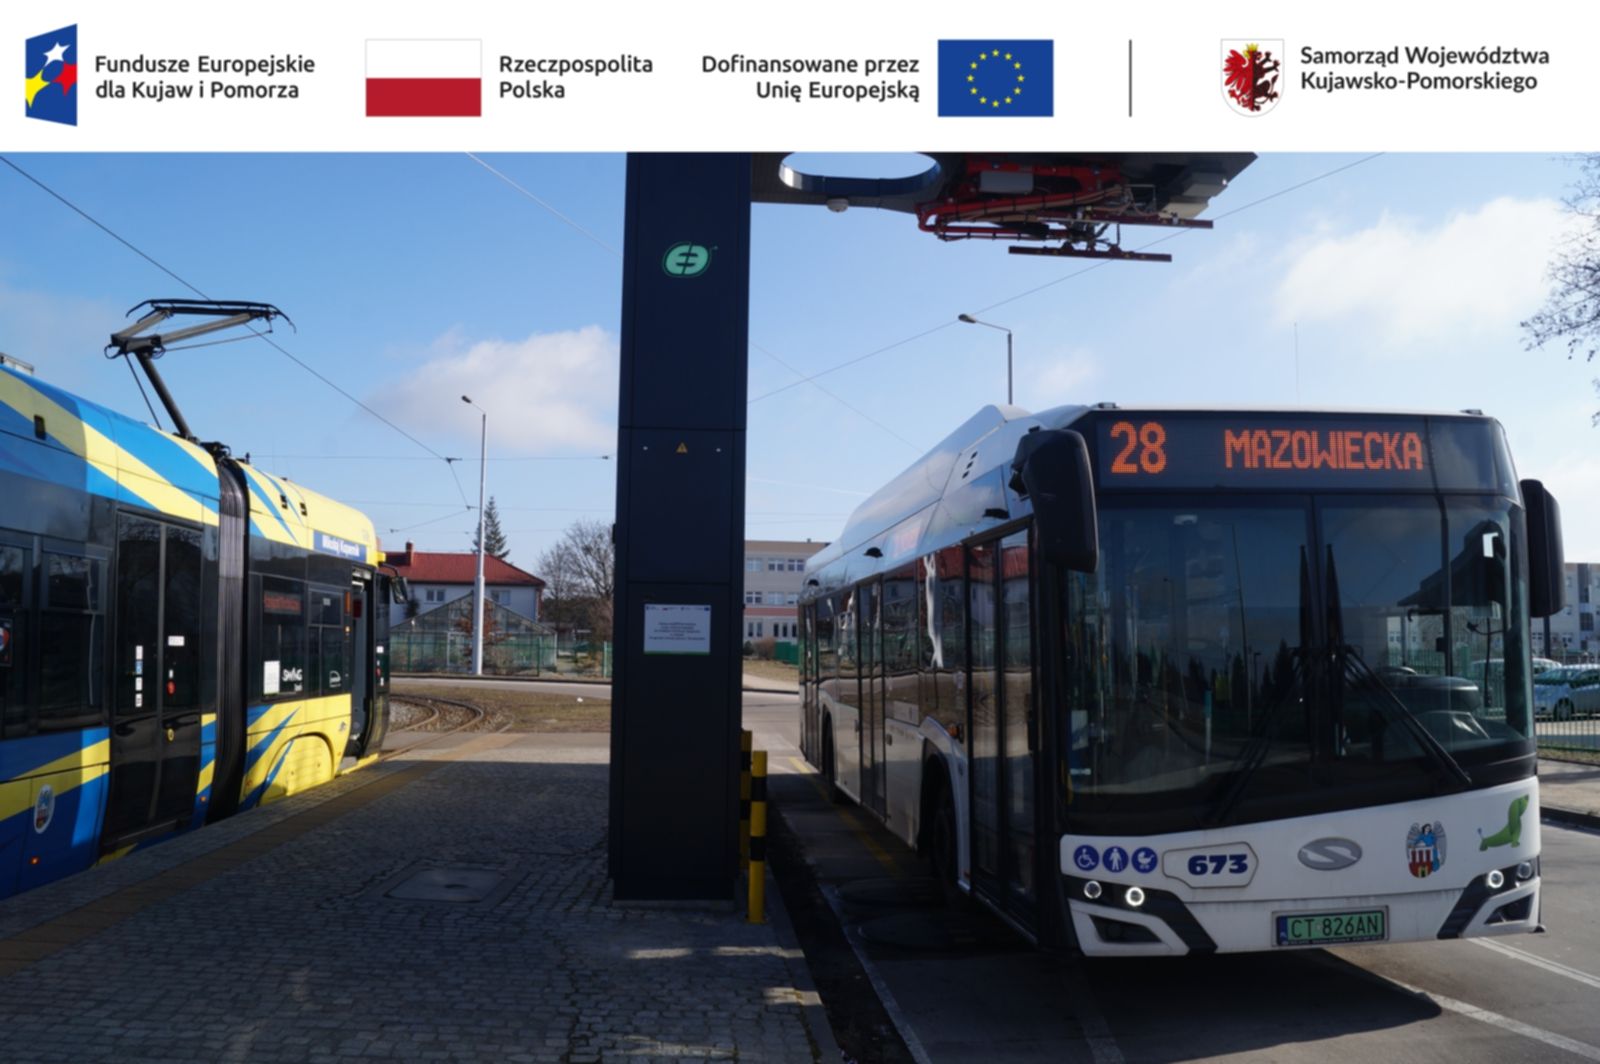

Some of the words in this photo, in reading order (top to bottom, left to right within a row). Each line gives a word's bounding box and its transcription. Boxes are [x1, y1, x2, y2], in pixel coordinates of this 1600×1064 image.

[1110, 421, 1167, 474] 28
[1224, 429, 1424, 470] MAZOWIECKA
[1187, 854, 1249, 876] 673
[1291, 918, 1315, 938] CT
[1322, 915, 1379, 937] 826AN
